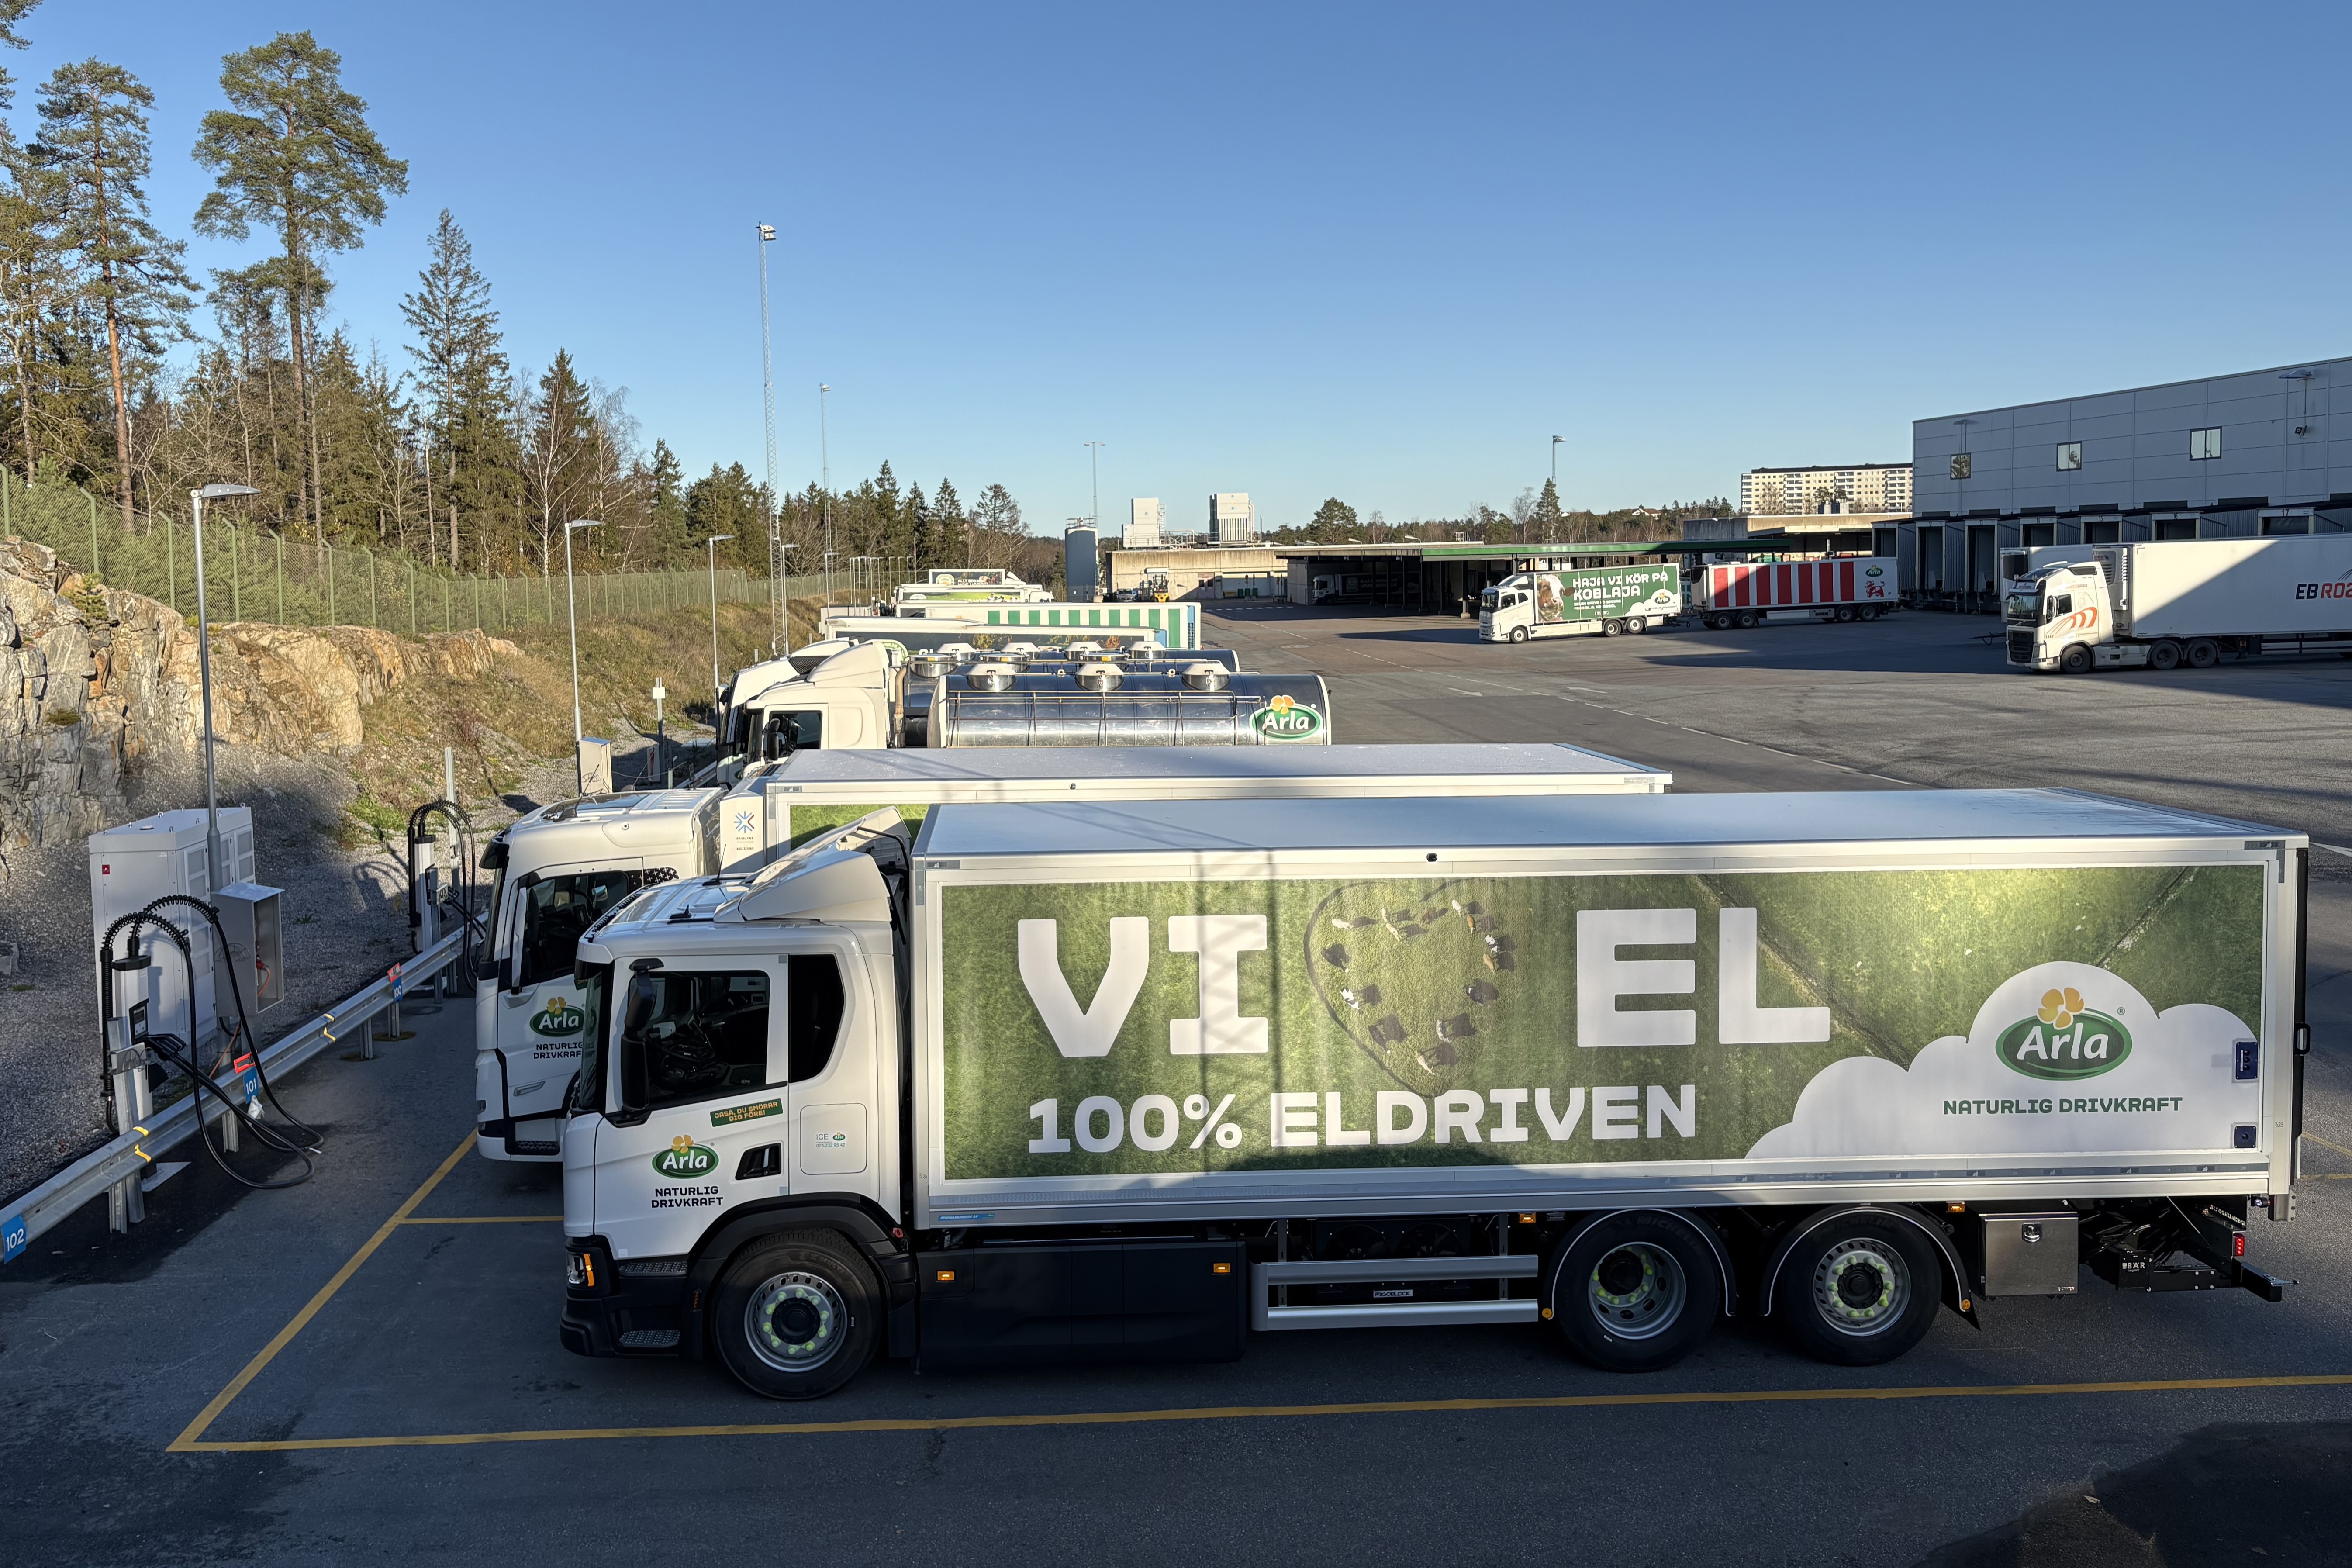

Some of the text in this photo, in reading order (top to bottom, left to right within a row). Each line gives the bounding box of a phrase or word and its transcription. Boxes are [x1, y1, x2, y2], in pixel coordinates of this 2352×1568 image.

[1573, 577, 1605, 588] HAJA
[1607, 575, 1622, 586] VI
[1625, 573, 1649, 584] KÖR
[1573, 585, 1641, 601] KOBLAJA
[1262, 711, 1309, 730] Arla
[1018, 907, 1830, 1057] VI EL
[394, 985, 402, 998] 100
[539, 1011, 579, 1029] Arla
[2017, 1022, 2109, 1060] Arla
[533, 1050, 581, 1059] DRIVKRAF
[246, 1078, 257, 1095] 101
[744, 1110, 766, 1119] FÖRE!
[748, 1102, 778, 1112] SMÖRAR
[1944, 1097, 2183, 1115] NATURLIG DRIVKRAFT
[1029, 1084, 1696, 1153] 100% ELDRIVEN
[662, 1150, 708, 1170] Arla
[655, 1185, 719, 1197] NATURLIG
[651, 1197, 724, 1208] DRIVKRAFT
[6, 1228, 24, 1252] 102
